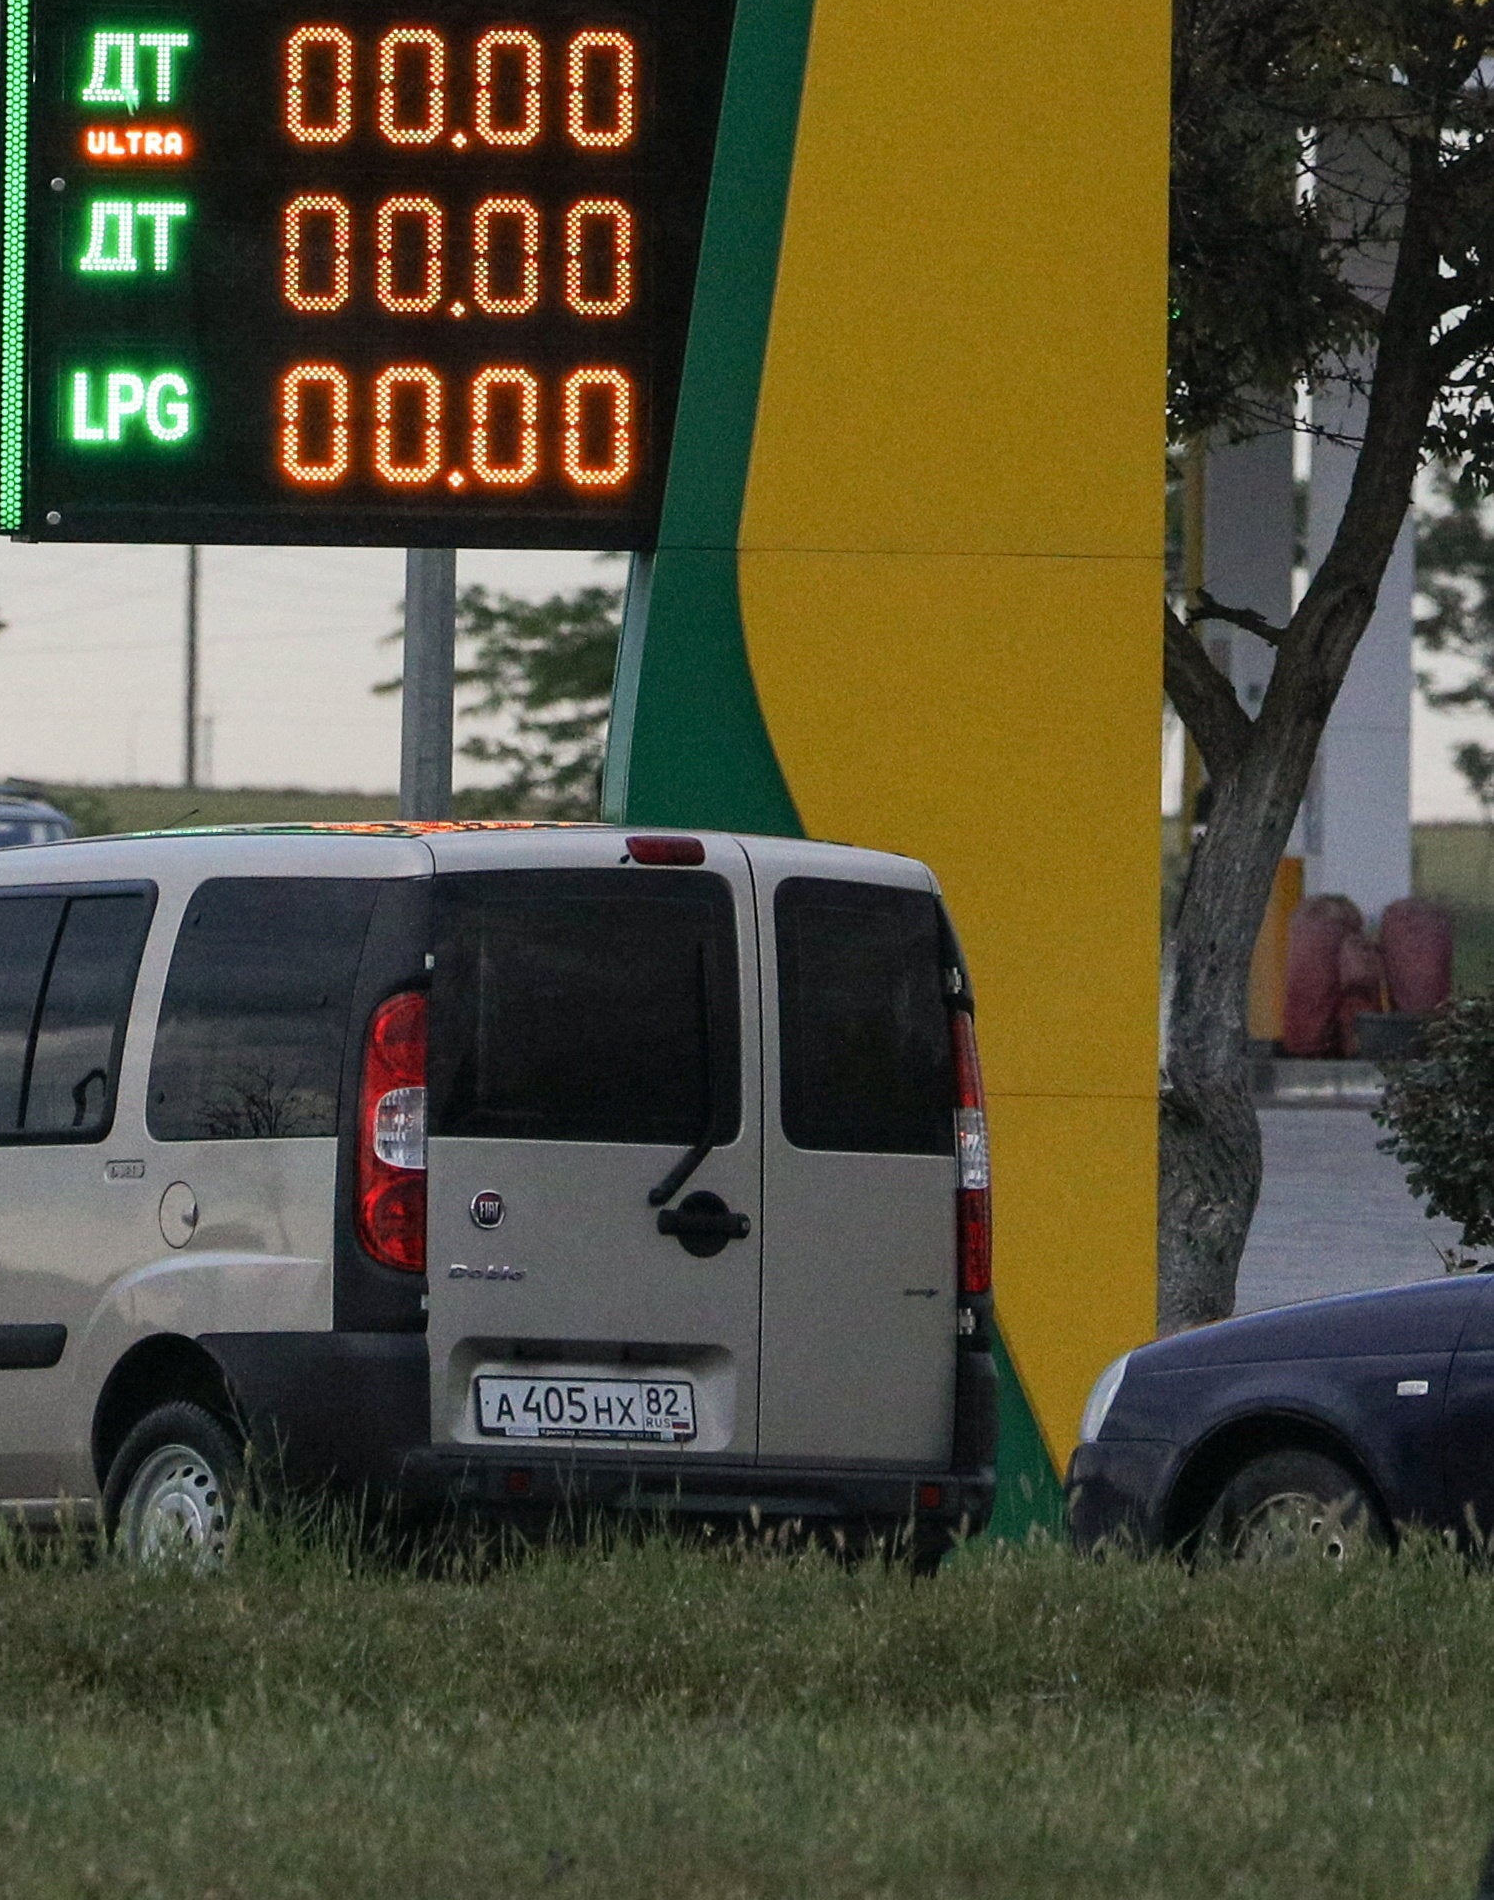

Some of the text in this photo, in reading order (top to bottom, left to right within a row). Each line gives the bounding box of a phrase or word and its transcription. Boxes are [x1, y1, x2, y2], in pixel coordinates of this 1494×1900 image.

[82, 26, 634, 149] ДТ 00.00
[87, 131, 183, 156] ULTRA
[79, 195, 632, 316] ДТ 00.00
[71, 364, 630, 487] LPG 00.00
[479, 1201, 500, 1219] FIAT
[646, 1386, 681, 1417] 82
[645, 1417, 672, 1430] RUS
